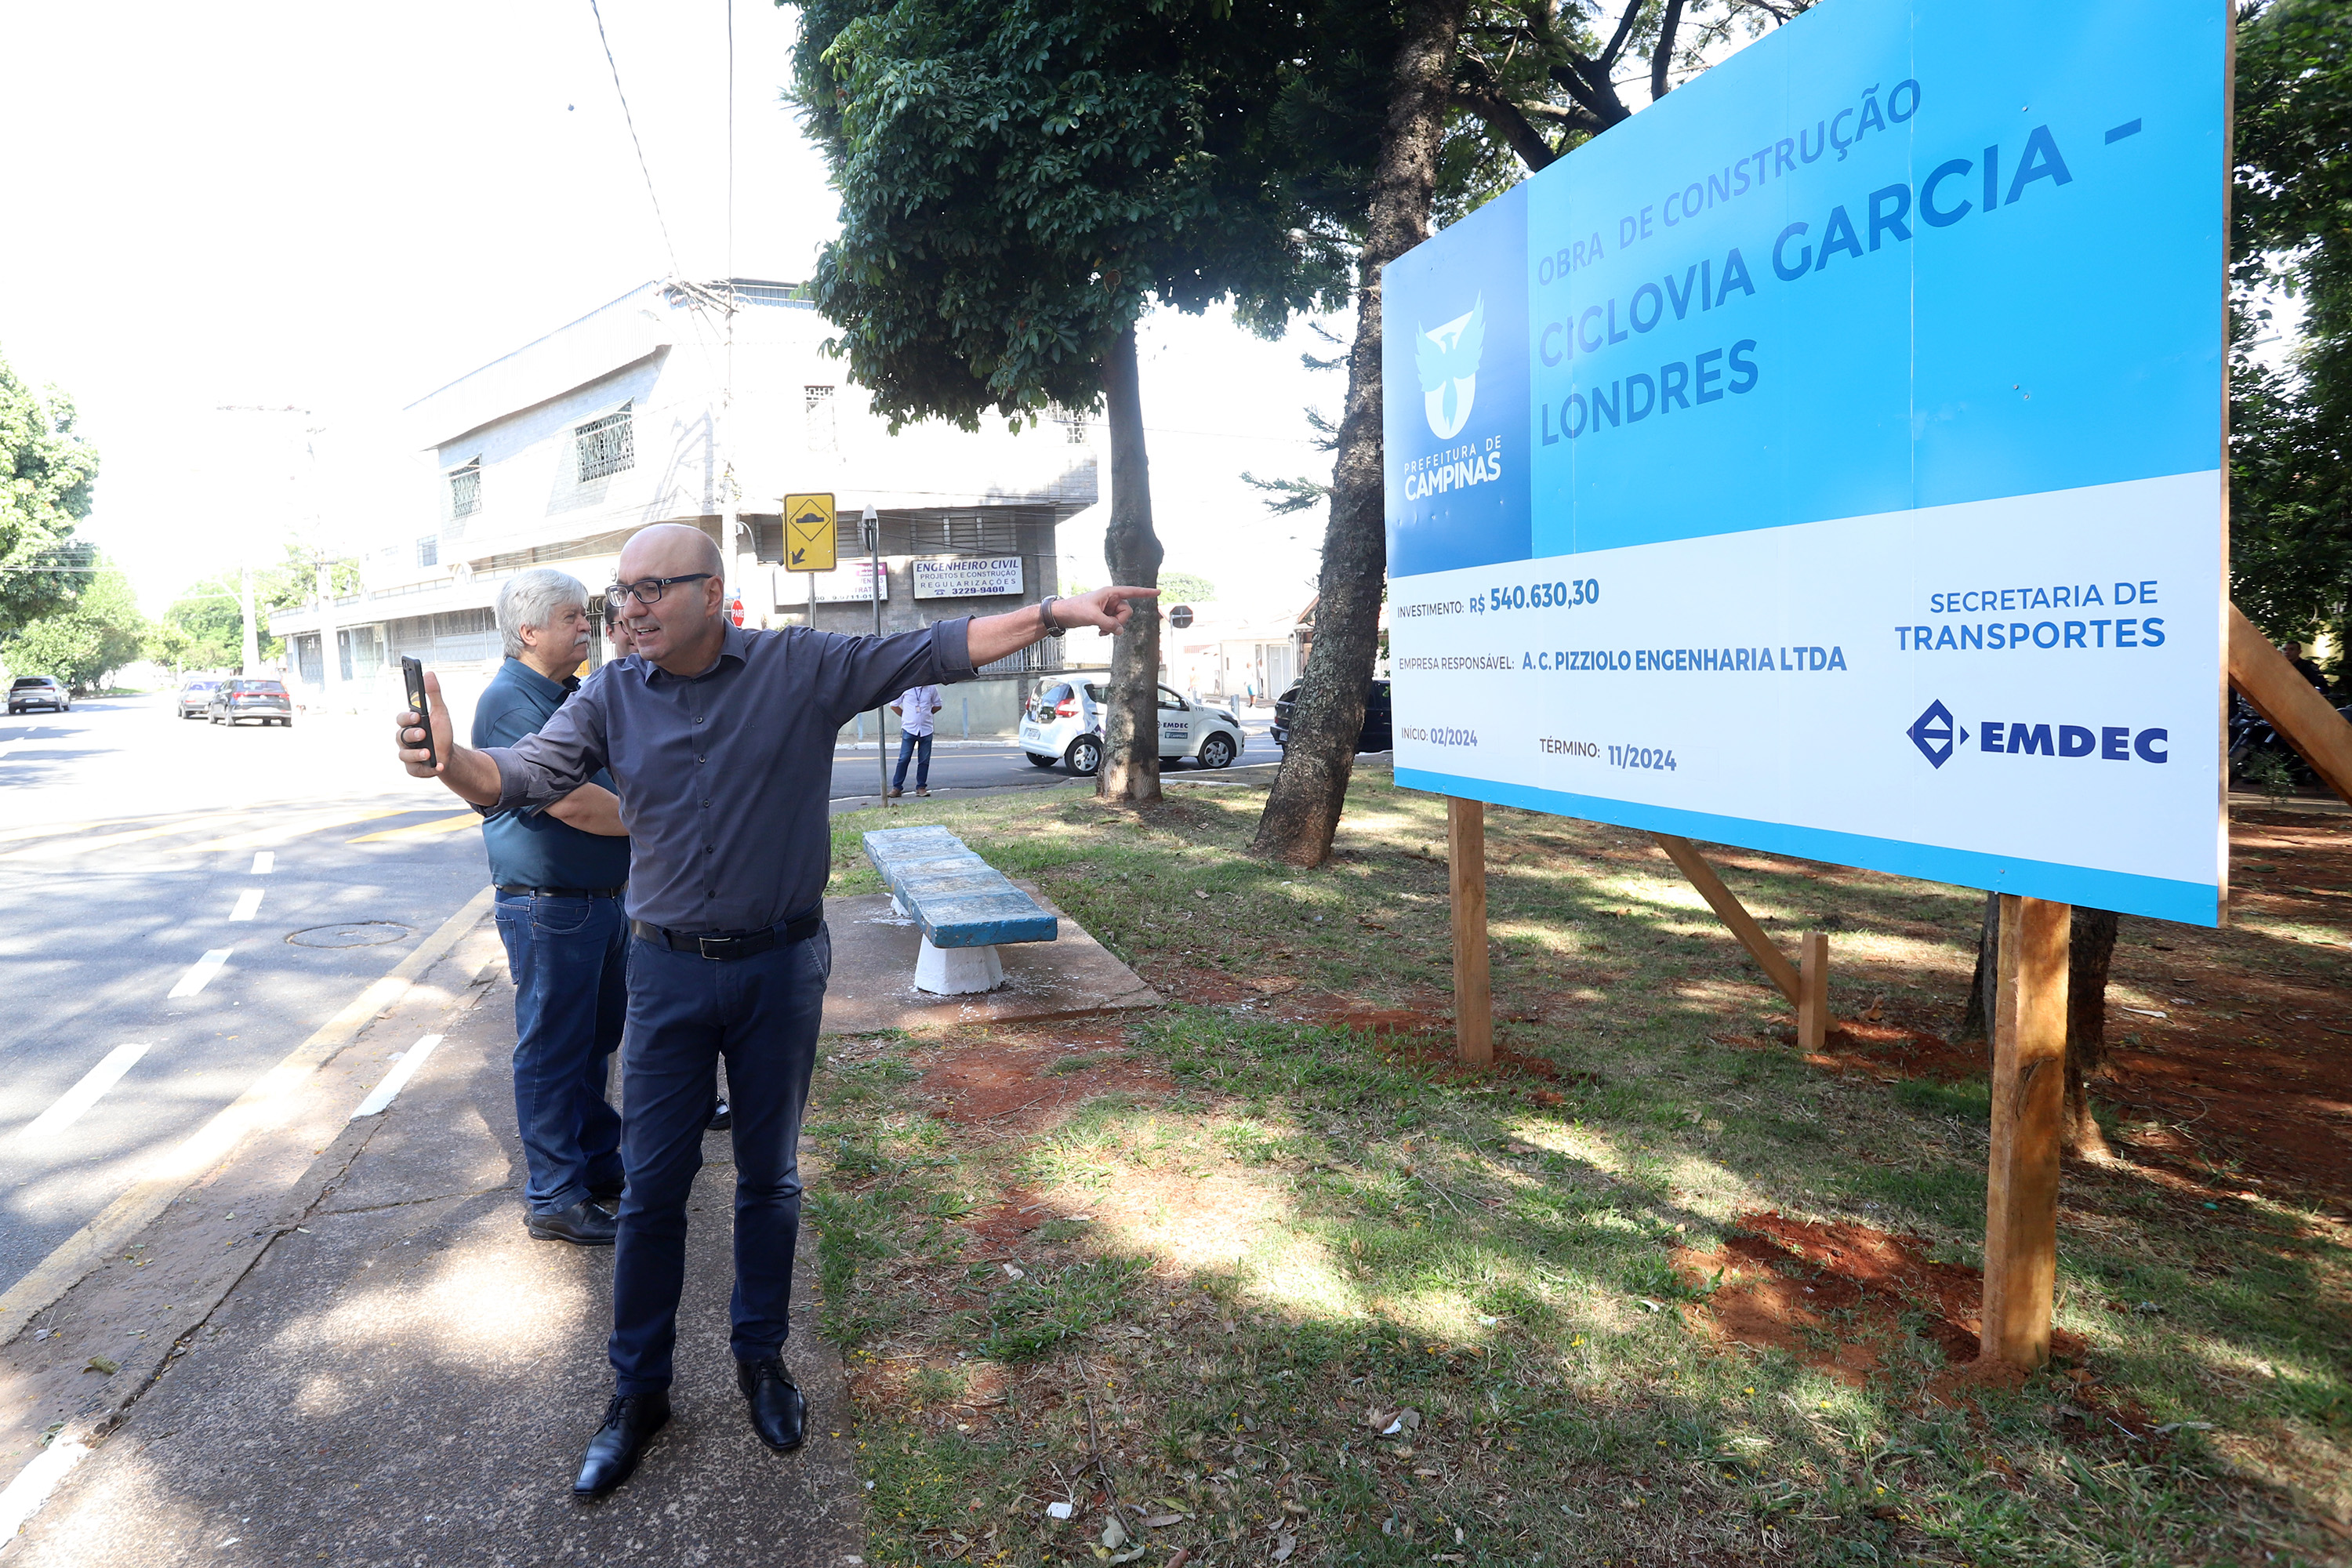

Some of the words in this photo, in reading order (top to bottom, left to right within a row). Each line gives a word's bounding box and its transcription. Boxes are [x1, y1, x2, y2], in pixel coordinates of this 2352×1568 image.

[1537, 231, 1605, 287] OBRA
[1619, 205, 1653, 251] DE
[1663, 78, 1921, 227] CONSTRUÇÃO
[1539, 248, 1756, 368] CICLOVIA
[1772, 124, 2074, 282] GARCIA
[1541, 339, 1759, 447] LONDRES
[1404, 443, 1476, 474] PREFEITURA
[1486, 434, 1501, 452] DE
[1404, 451, 1501, 501] CAMPINAS
[916, 561, 988, 572] ENGENHEIRO
[991, 560, 1018, 569] CIVIL
[921, 578, 1016, 588] REGULARIZAÇÕES
[967, 569, 1016, 579] CONSTRUÇÃO
[732, 608, 744, 618] PARE
[1398, 601, 1465, 619] INVESTIMENTO:
[1469, 593, 1485, 615] R$
[1490, 578, 1599, 612] 540.630,30
[1930, 584, 2104, 613] SECRETARIA
[2114, 580, 2158, 605] DE
[1894, 617, 2165, 651] TRANSPORTES
[1399, 656, 1439, 670] EMPRESA
[1442, 652, 1515, 670] RESPONSÁVEL:
[1555, 650, 1632, 671] PIZZIOLO
[1635, 647, 1776, 671] ENGENHARIA
[1780, 645, 1847, 671] LTDA
[1401, 726, 1428, 742] INÍCIO:
[1430, 727, 1478, 747] 02/2024
[1539, 735, 1601, 759] TÉRMINO:
[1608, 744, 1677, 771] 11/2024
[1980, 721, 2169, 764] EMDEC
